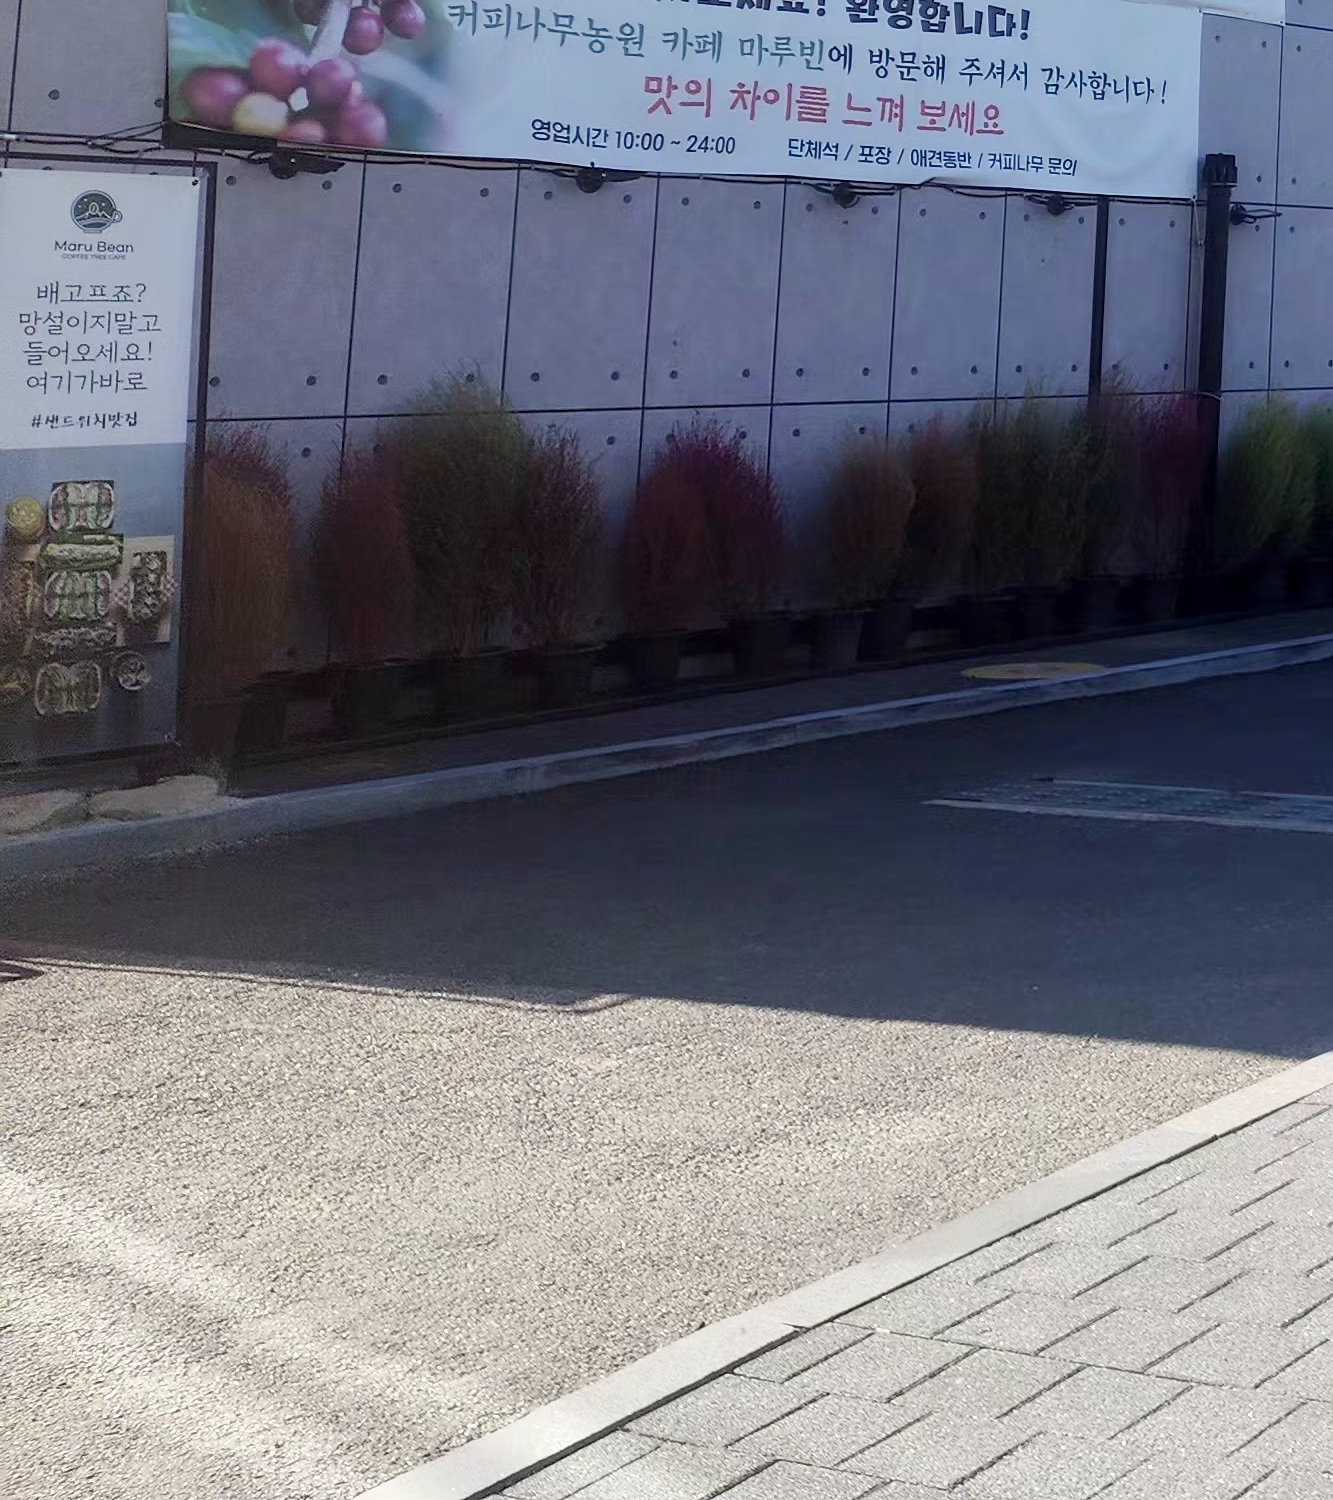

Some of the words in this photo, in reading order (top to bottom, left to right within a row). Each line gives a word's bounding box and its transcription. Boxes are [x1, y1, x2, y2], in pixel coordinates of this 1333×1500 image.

[448, 0, 645, 58] 커피나무농원
[662, 27, 723, 64] 카페
[738, 33, 853, 73] 마루빈에
[868, 47, 947, 86] 방문해
[958, 56, 1029, 92] 주셔서
[1040, 65, 1168, 105] 감사합니다!
[643, 75, 712, 118] 맛의
[728, 80, 829, 124] 차이를
[842, 92, 904, 132] 느껴
[916, 99, 1005, 136] 보세요
[531, 119, 609, 149] 영업시간
[615, 131, 665, 152] 10:00
[685, 134, 736, 155] 24:00
[787, 138, 838, 160] 단체석
[857, 145, 892, 166] 포장
[910, 150, 972, 169] 애견동반
[989, 153, 1044, 173] 커피나무
[1047, 158, 1077, 177] 문의
[54, 240, 93, 252] Maru
[97, 240, 134, 253] Bean
[36, 280, 147, 304] 배고프죠?
[19, 310, 162, 336] 망설이지말고
[23, 340, 152, 366] 들어오세요!
[26, 370, 148, 395] 여기가바로
